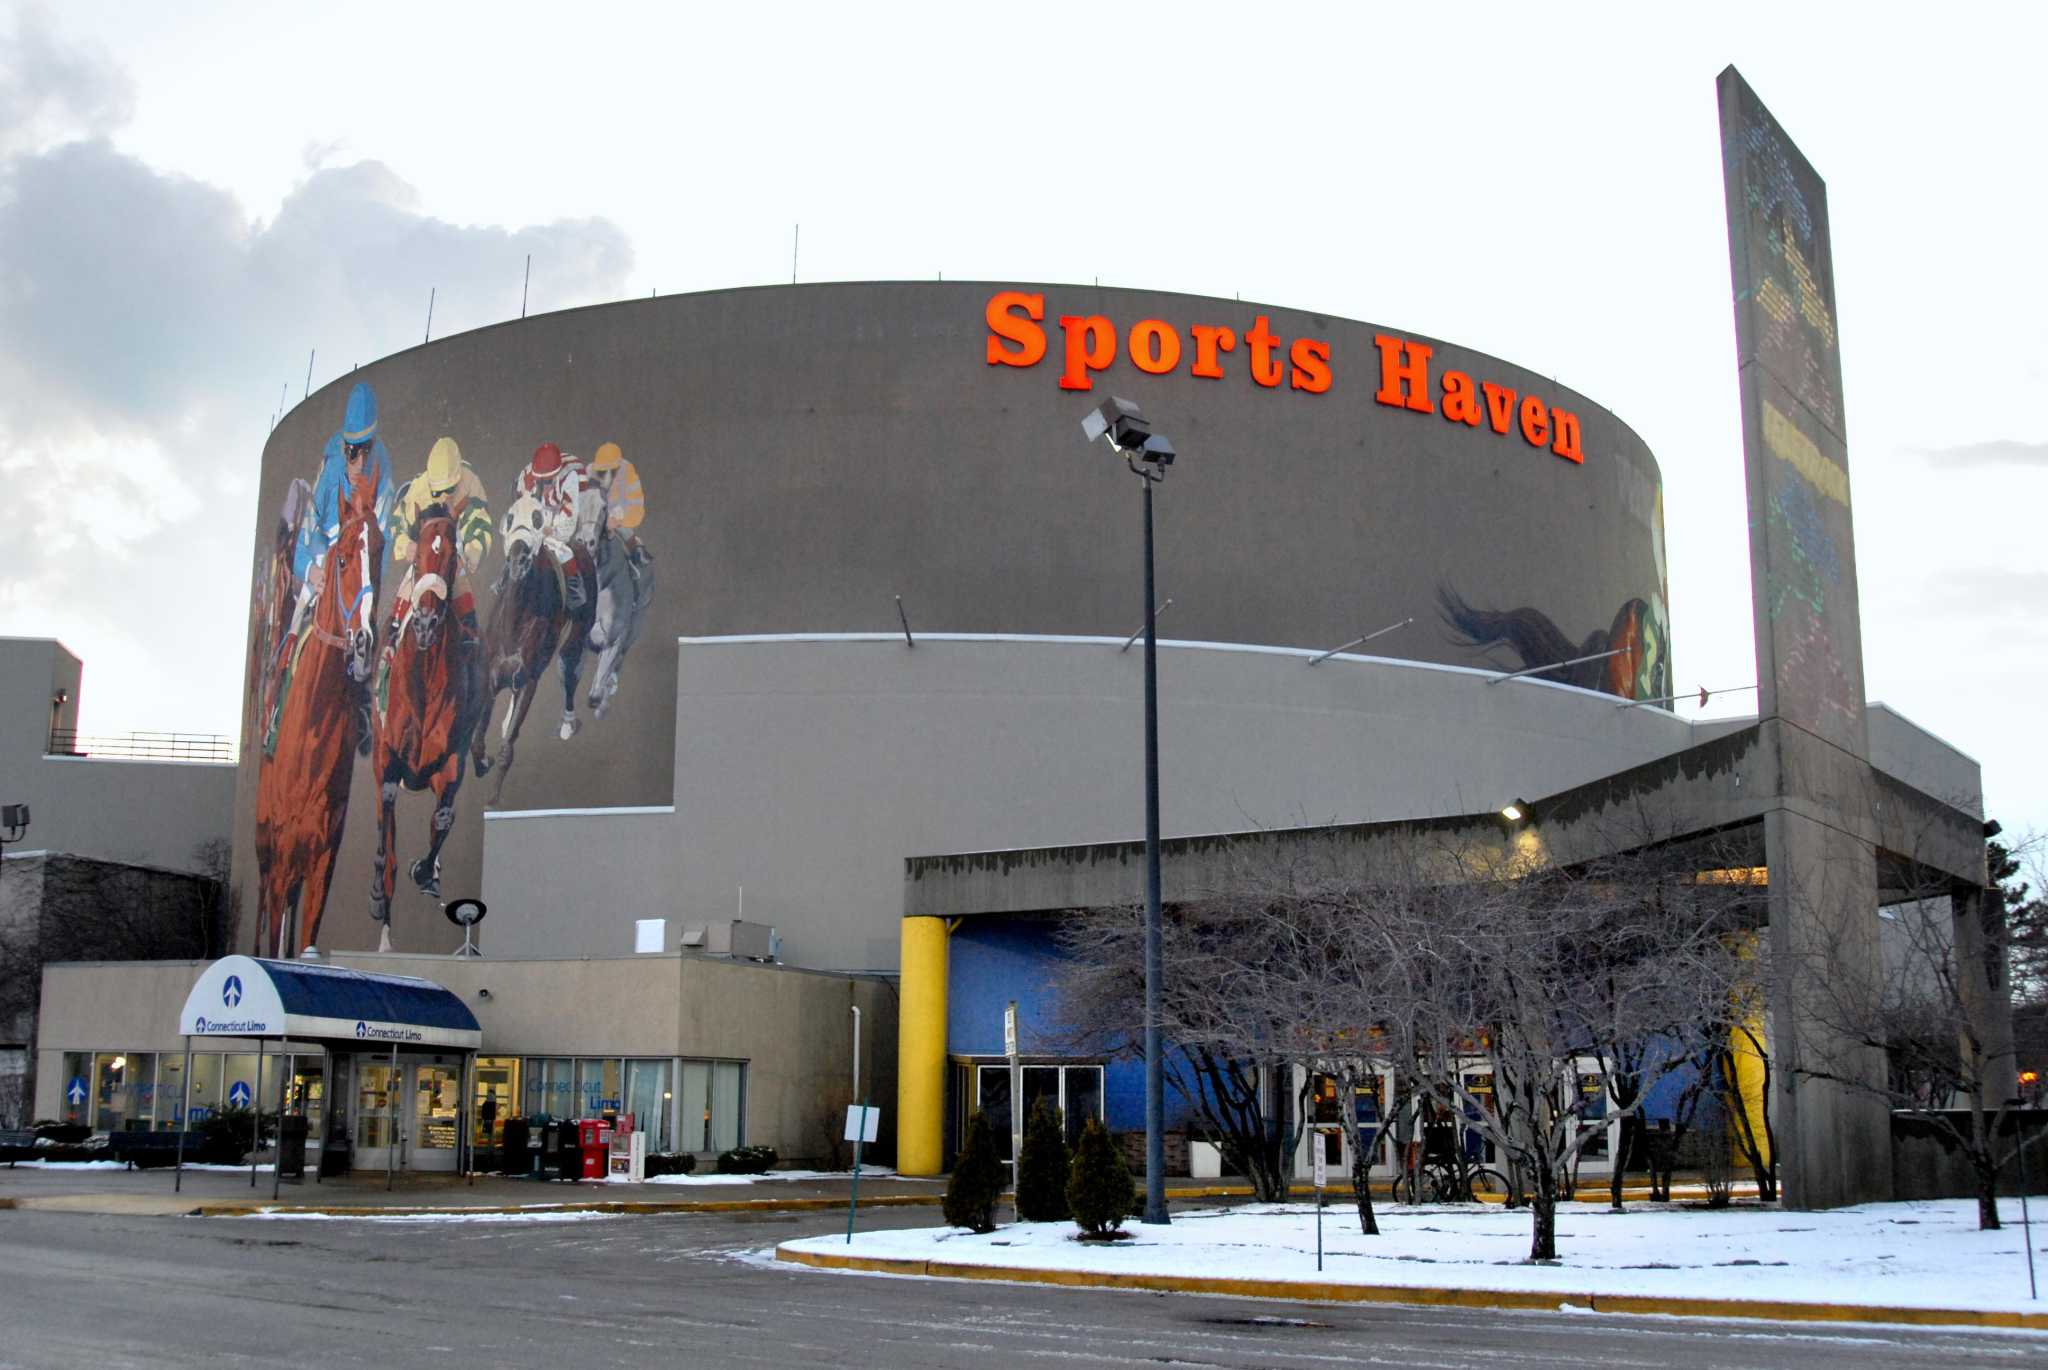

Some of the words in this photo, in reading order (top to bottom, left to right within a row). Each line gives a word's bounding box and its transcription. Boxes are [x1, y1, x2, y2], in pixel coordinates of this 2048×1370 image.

[985, 291, 1333, 394] Sports
[1374, 332, 1584, 465] Haven
[207, 1021, 246, 1032] Connecticut
[247, 1021, 266, 1031] Limo
[367, 1026, 404, 1039] Connecticut
[405, 1029, 422, 1041] Limo
[590, 1096, 621, 1110] Limo
[173, 1102, 217, 1121] Lmo
